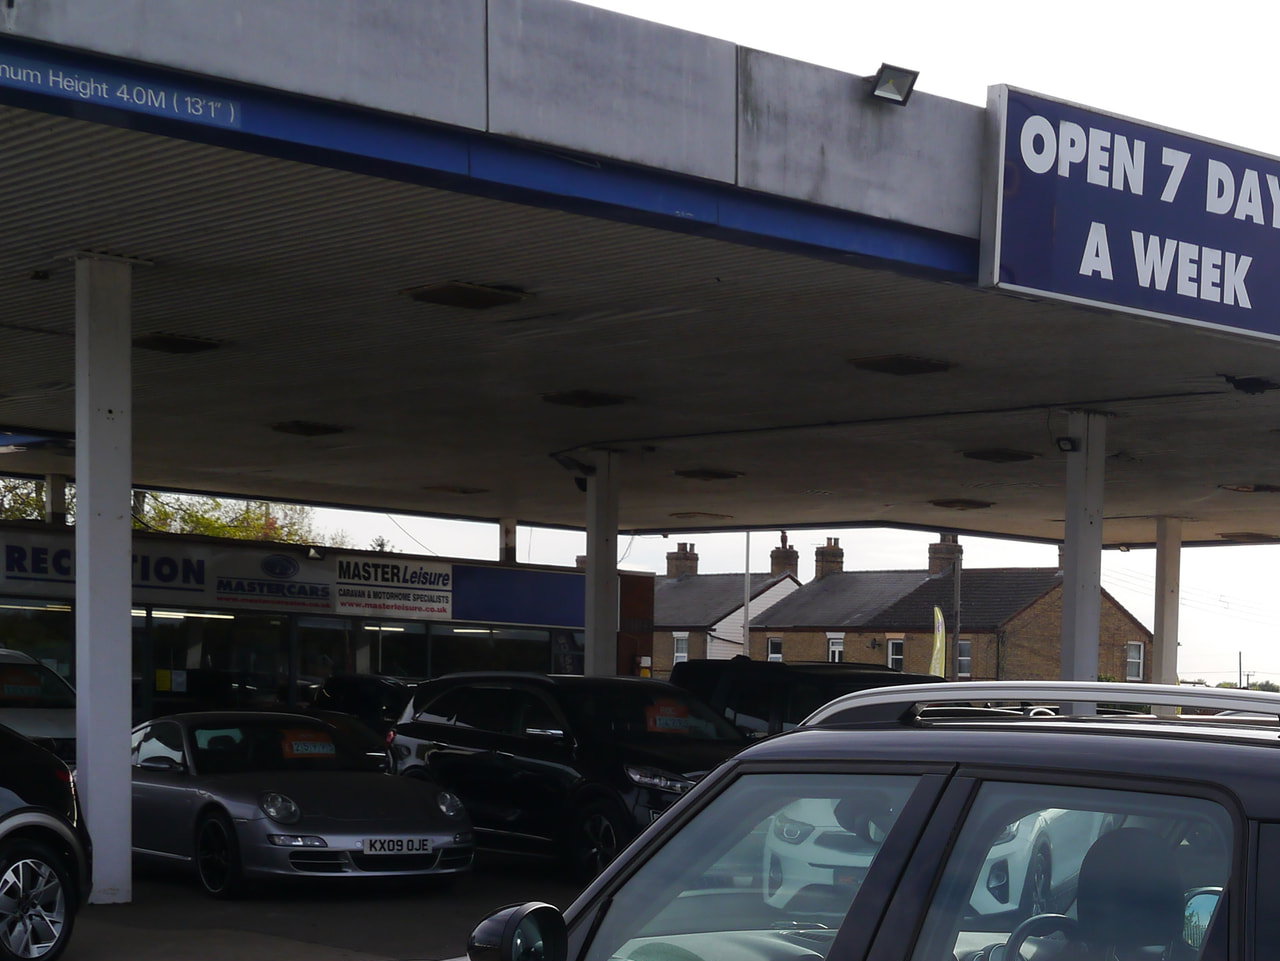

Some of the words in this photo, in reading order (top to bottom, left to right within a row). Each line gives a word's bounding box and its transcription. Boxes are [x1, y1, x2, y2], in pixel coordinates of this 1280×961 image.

[50, 69, 108, 98] Height
[116, 84, 166, 109] 4.0M
[1020, 114, 1146, 196] OPEN
[1160, 146, 1191, 203] 7
[1078, 221, 1114, 280] A
[1131, 230, 1253, 309] WEEK
[6, 545, 205, 585] RECION
[216, 579, 330, 598] MASTERCARS
[338, 588, 366, 599] CARAVAN
[373, 591, 411, 602] MOTORHOME
[412, 594, 449, 604] SPECIALISTS
[369, 839, 404, 852] KX09
[407, 838, 429, 852] OJE
